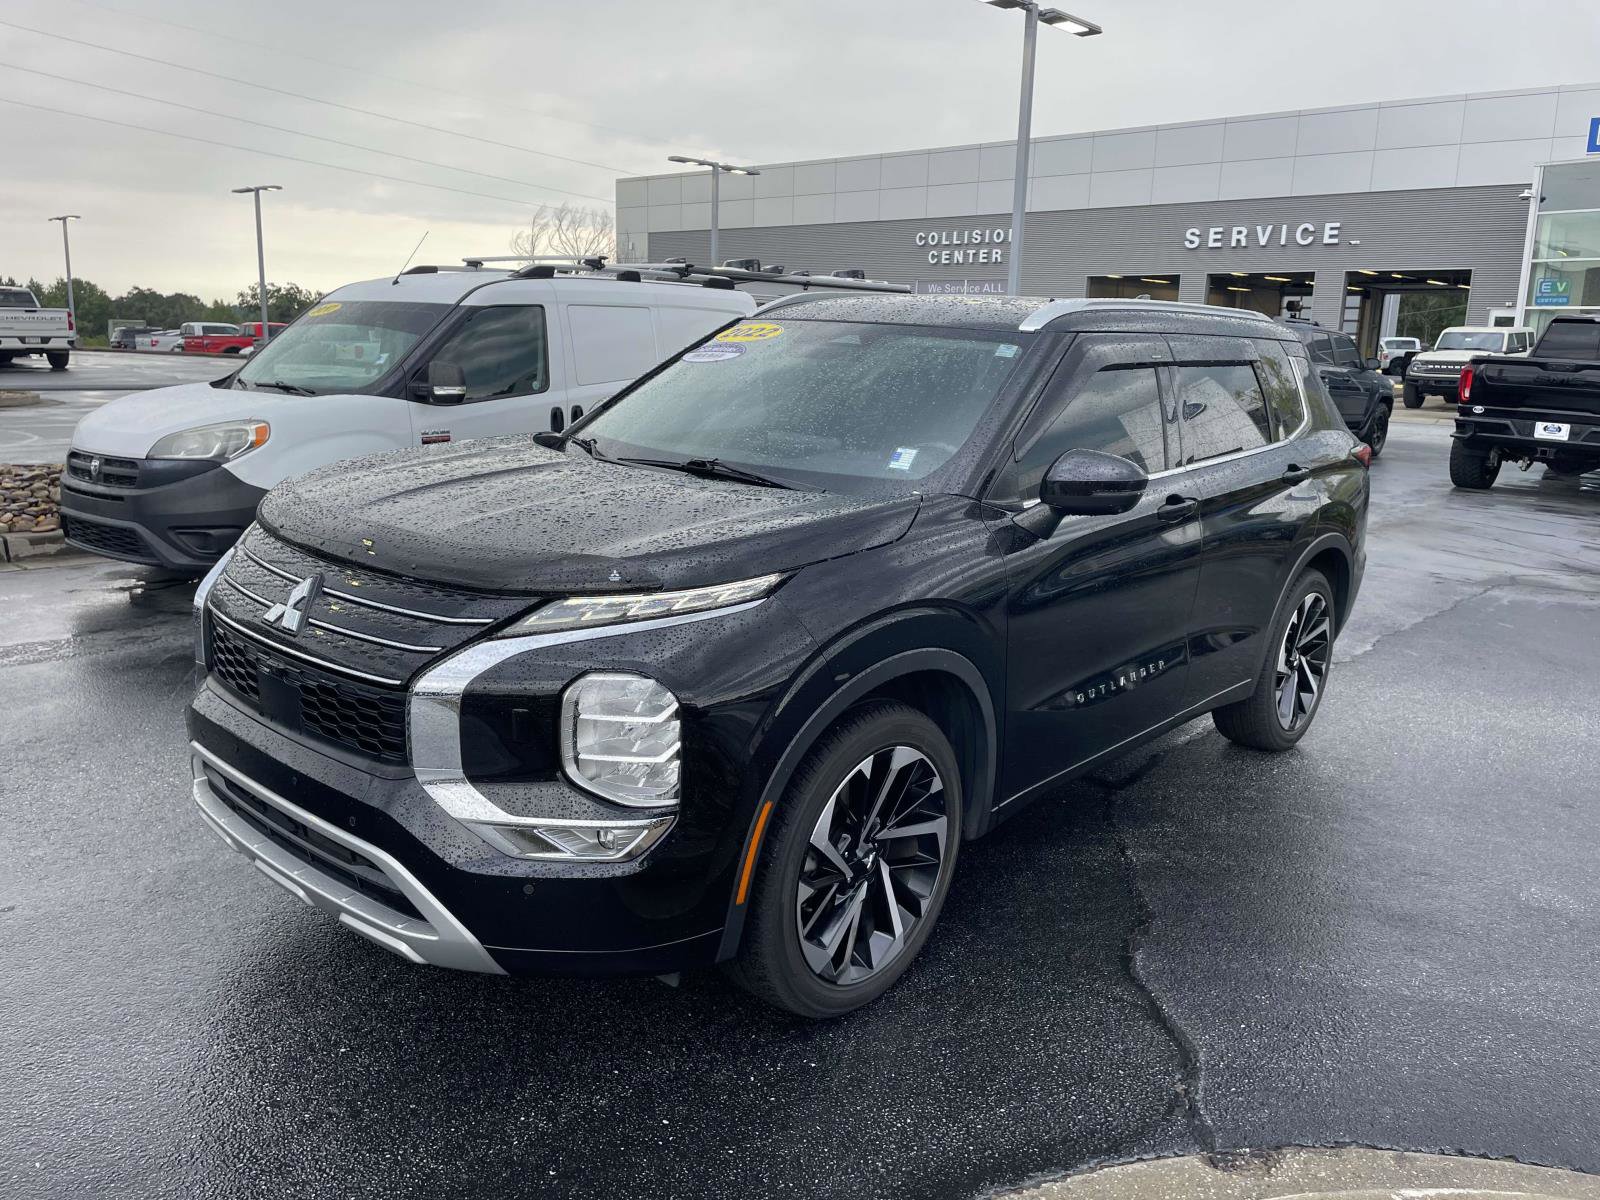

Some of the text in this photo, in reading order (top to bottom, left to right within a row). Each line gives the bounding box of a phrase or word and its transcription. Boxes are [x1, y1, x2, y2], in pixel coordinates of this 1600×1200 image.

[1184, 222, 1341, 249] SERVICE
[928, 248, 1003, 264] CENTER
[928, 282, 1005, 293] We Service ALL
[1541, 281, 1567, 292] EV
[1077, 660, 1167, 703] OUTLANDER
